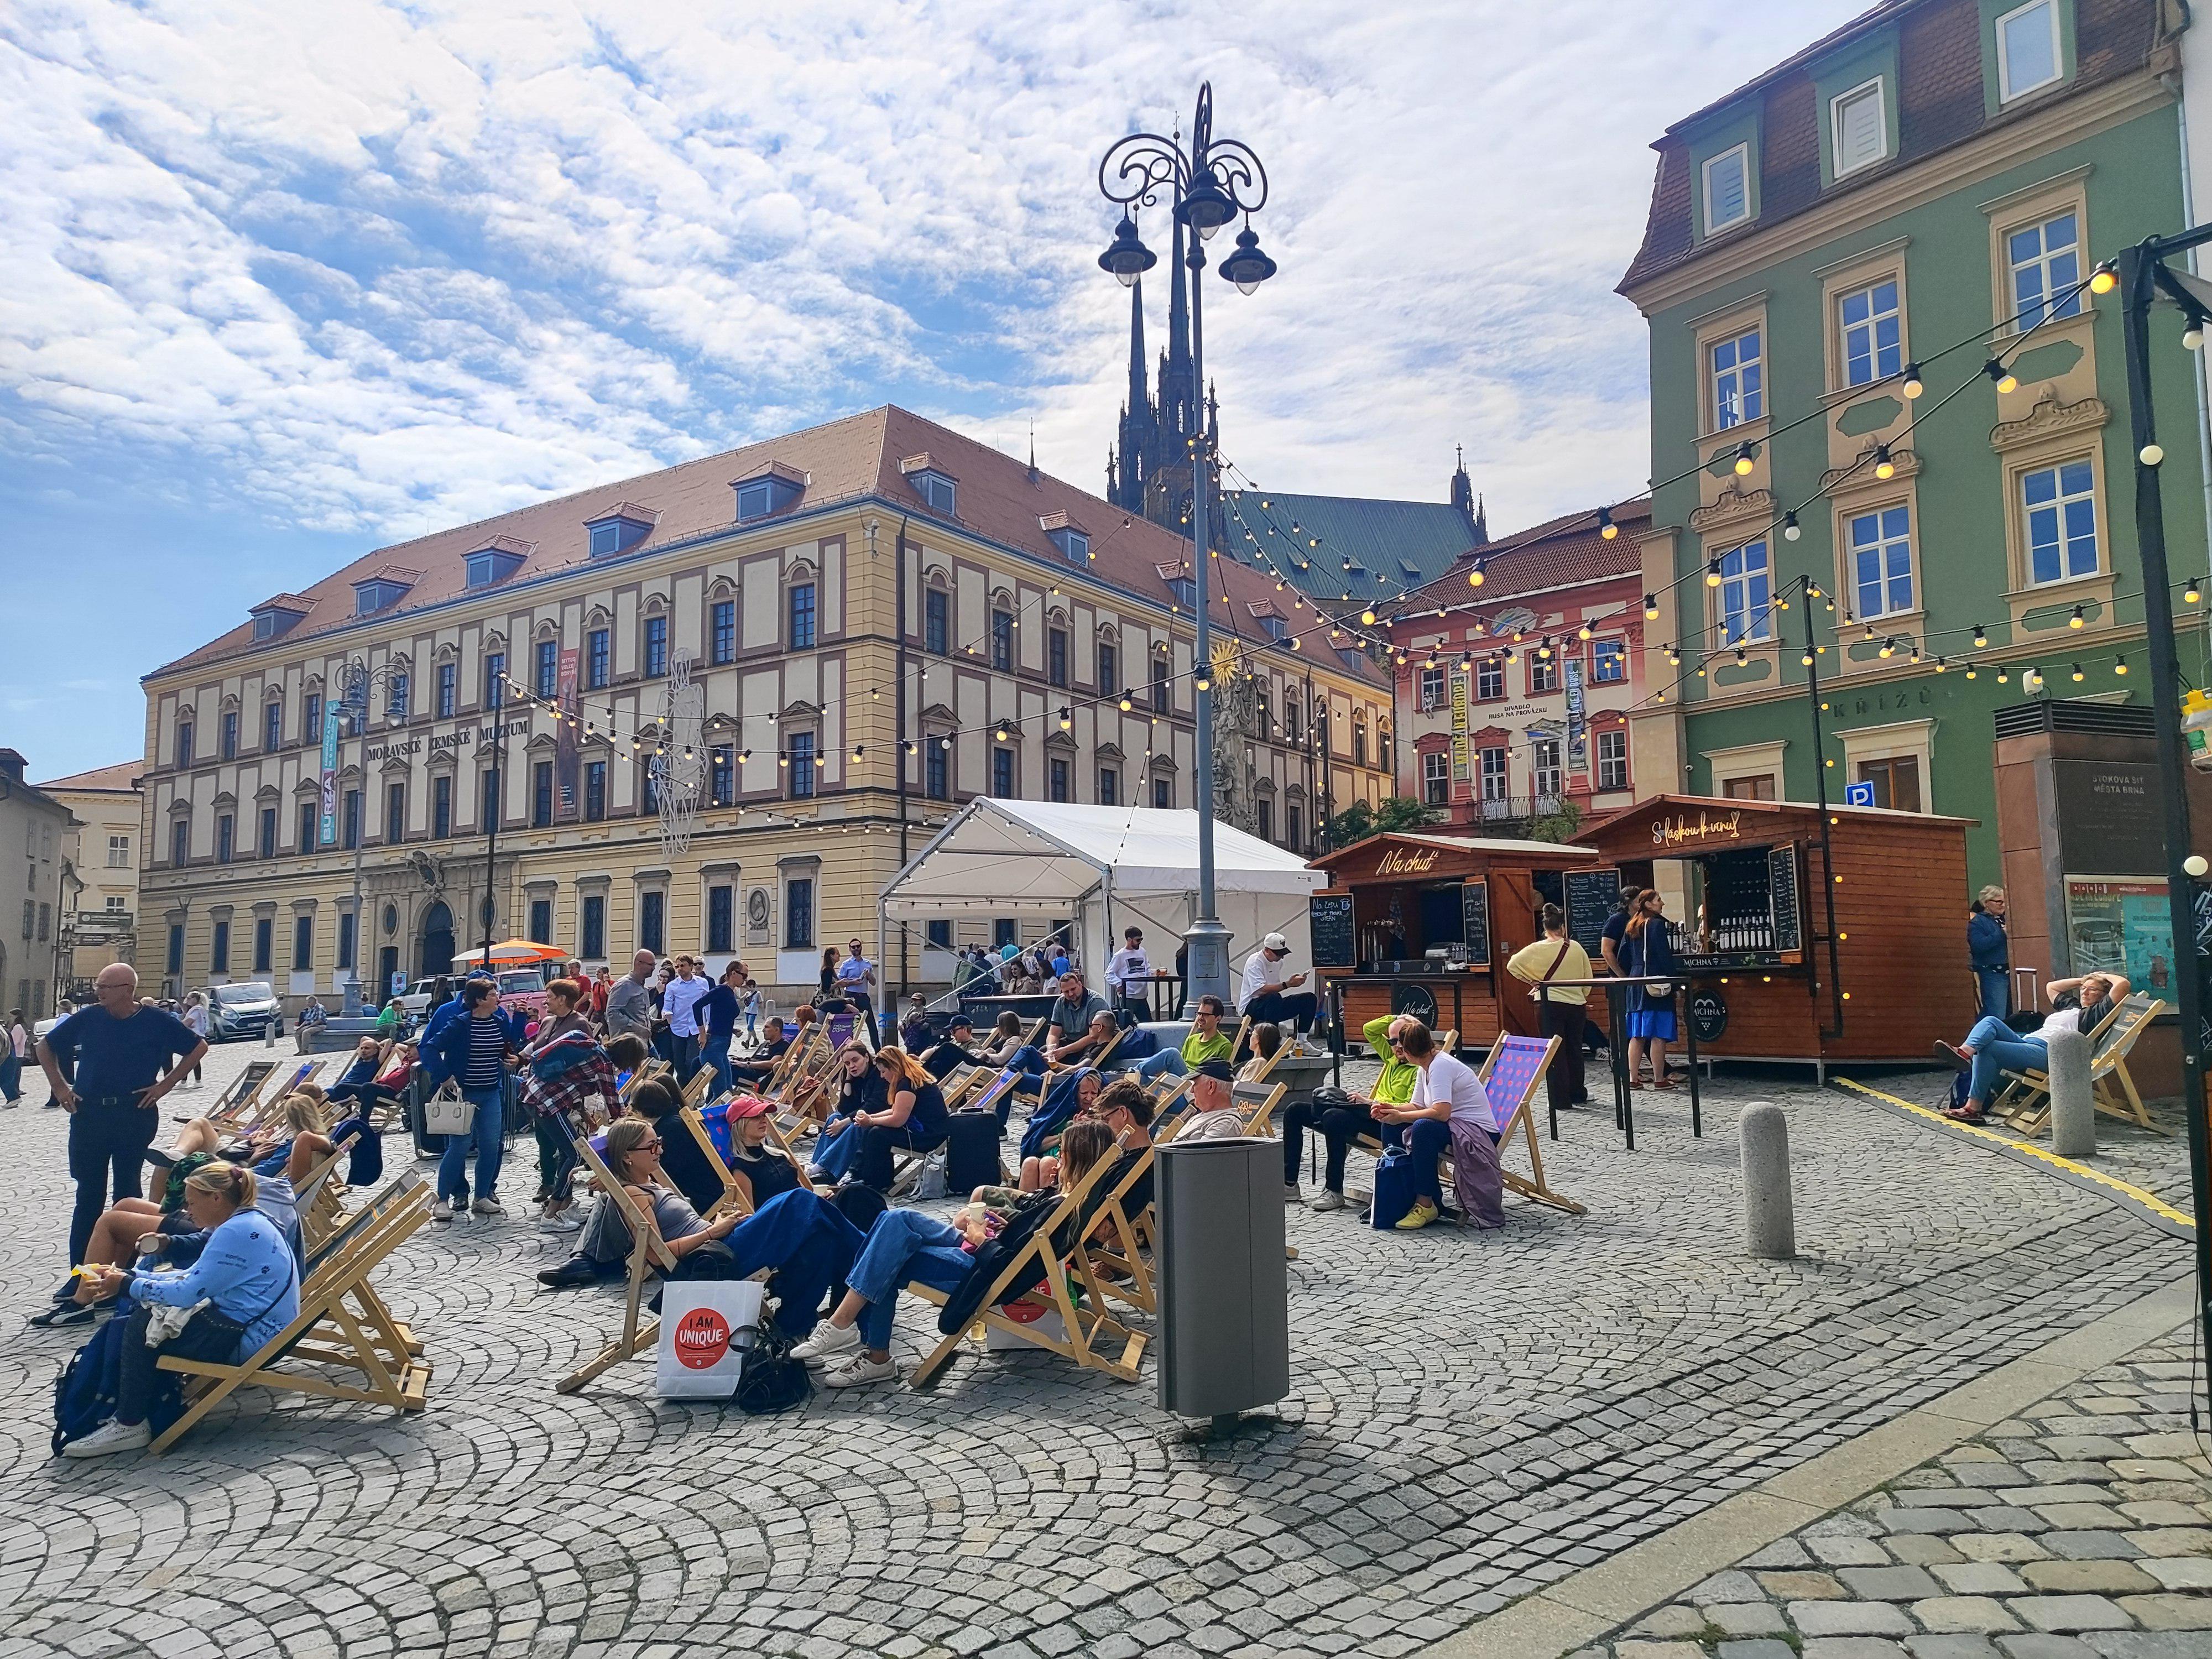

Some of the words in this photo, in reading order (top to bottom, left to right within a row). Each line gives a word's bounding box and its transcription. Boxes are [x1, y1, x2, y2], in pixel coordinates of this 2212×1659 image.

[1568, 669, 1579, 687] ROSE
[1504, 703, 1531, 712] DIVADLO
[1516, 707, 1547, 716] PROVÁZKU
[367, 737, 421, 761] MORAVSKÉ
[428, 728, 471, 750] ZEMSKÉ
[1852, 788, 1869, 806] P
[2122, 786, 2145, 794] BRNA
[323, 776, 332, 840] BURZA
[1652, 821, 1662, 844] S
[1665, 814, 1699, 847] láskou
[1700, 811, 1709, 839] k
[1376, 848, 1404, 876] Na
[1683, 958, 1712, 967] MICHNA
[690, 1318, 692, 1328] I
[696, 1316, 713, 1328] AM
[680, 1329, 724, 1347] UNIQUE
